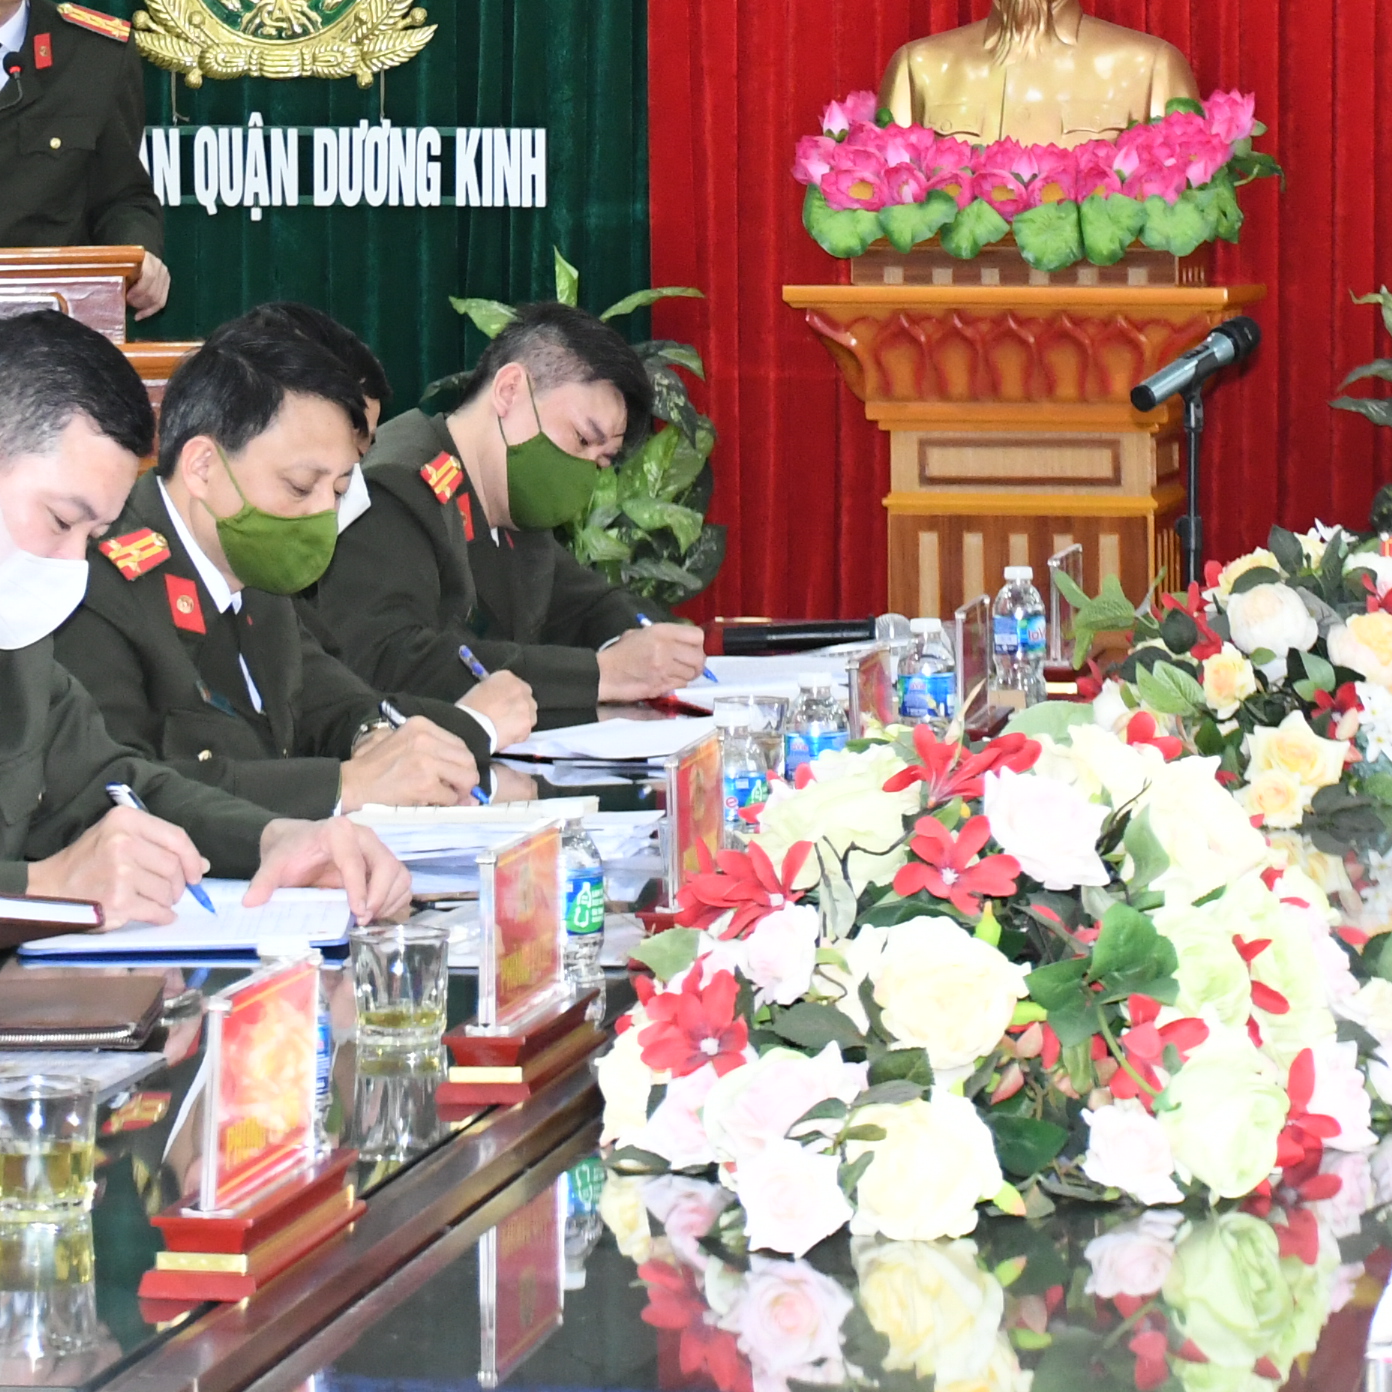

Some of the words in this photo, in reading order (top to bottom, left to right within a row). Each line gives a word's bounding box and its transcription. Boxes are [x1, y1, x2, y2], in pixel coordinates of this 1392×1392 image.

[194, 112, 299, 221] QUẬN
[313, 118, 442, 208] DƯƠNG
[455, 127, 547, 208] KINH
